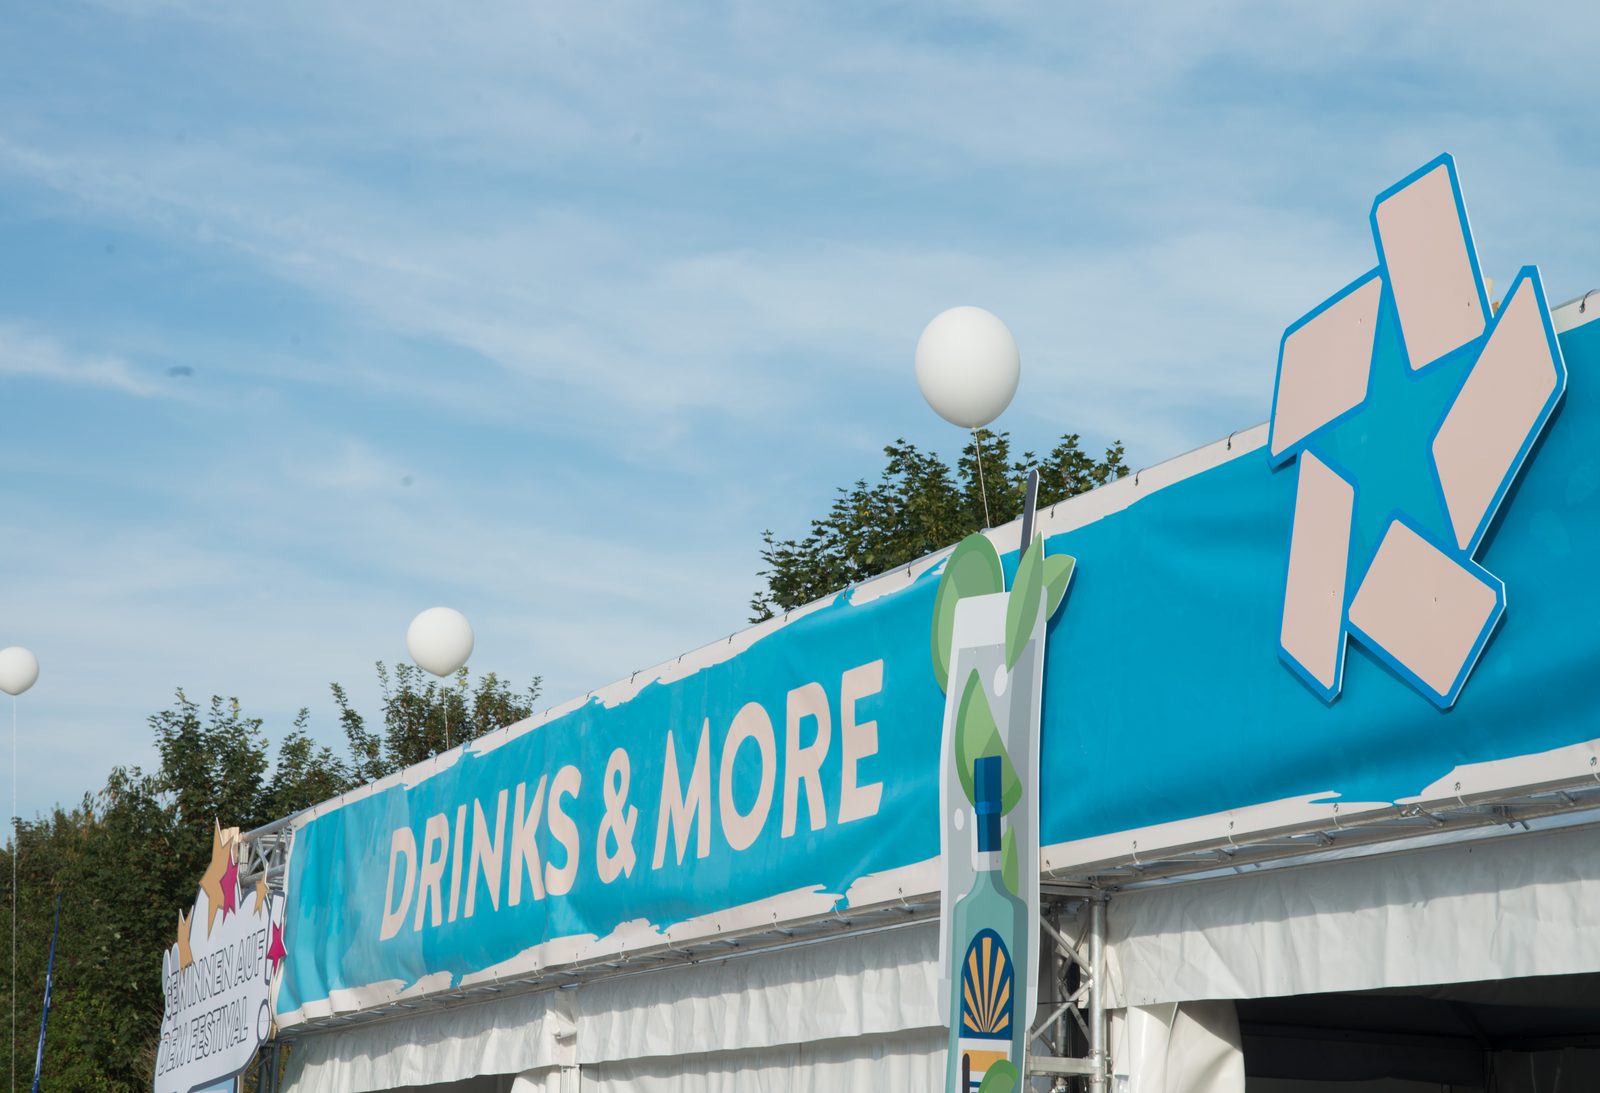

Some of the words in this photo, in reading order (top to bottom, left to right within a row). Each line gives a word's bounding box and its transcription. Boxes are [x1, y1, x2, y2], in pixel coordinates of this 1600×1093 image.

[380, 765, 582, 941] DRINKS
[596, 747, 638, 884] &
[652, 659, 884, 870] MORE
[165, 944, 233, 1021] GEWINNEN
[234, 929, 266, 985] AUF
[158, 1024, 188, 1076] DEM
[187, 996, 248, 1063] FESTIVAL
